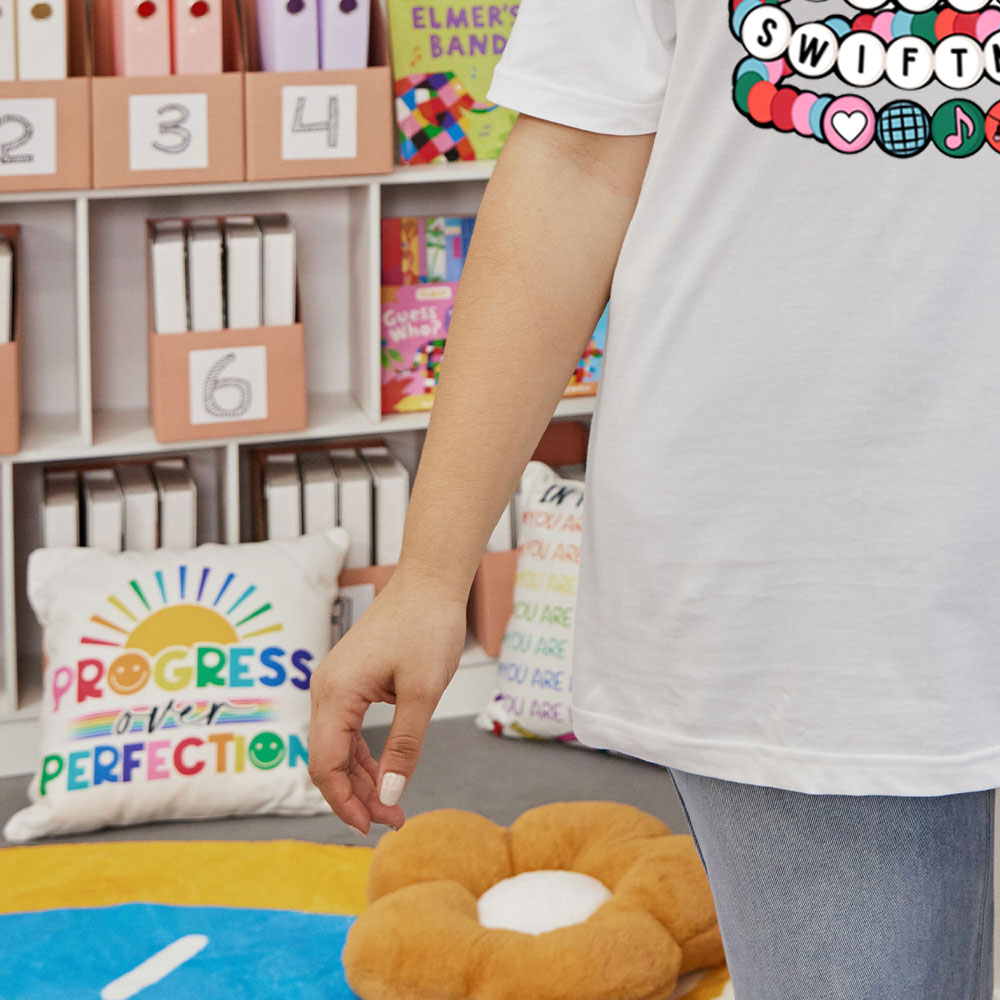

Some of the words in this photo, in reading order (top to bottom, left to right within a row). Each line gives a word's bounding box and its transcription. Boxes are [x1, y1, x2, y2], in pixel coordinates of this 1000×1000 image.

[429, 34, 507, 58] BAND
[152, 102, 193, 155] 3
[292, 96, 339, 148] 4
[0, 113, 34, 164] 2
[383, 306, 438, 328] Guess
[387, 318, 443, 343] Who?
[202, 353, 252, 418] 6
[551, 544, 580, 564] AR
[514, 601, 538, 622] OU
[540, 604, 574, 628] ARE
[535, 636, 567, 659] ARE
[52, 646, 314, 713] PROGRESS
[531, 667, 564, 691] ARE
[116, 700, 234, 735] over
[529, 699, 562, 720] ARE
[39, 732, 310, 797] PERFECTION
